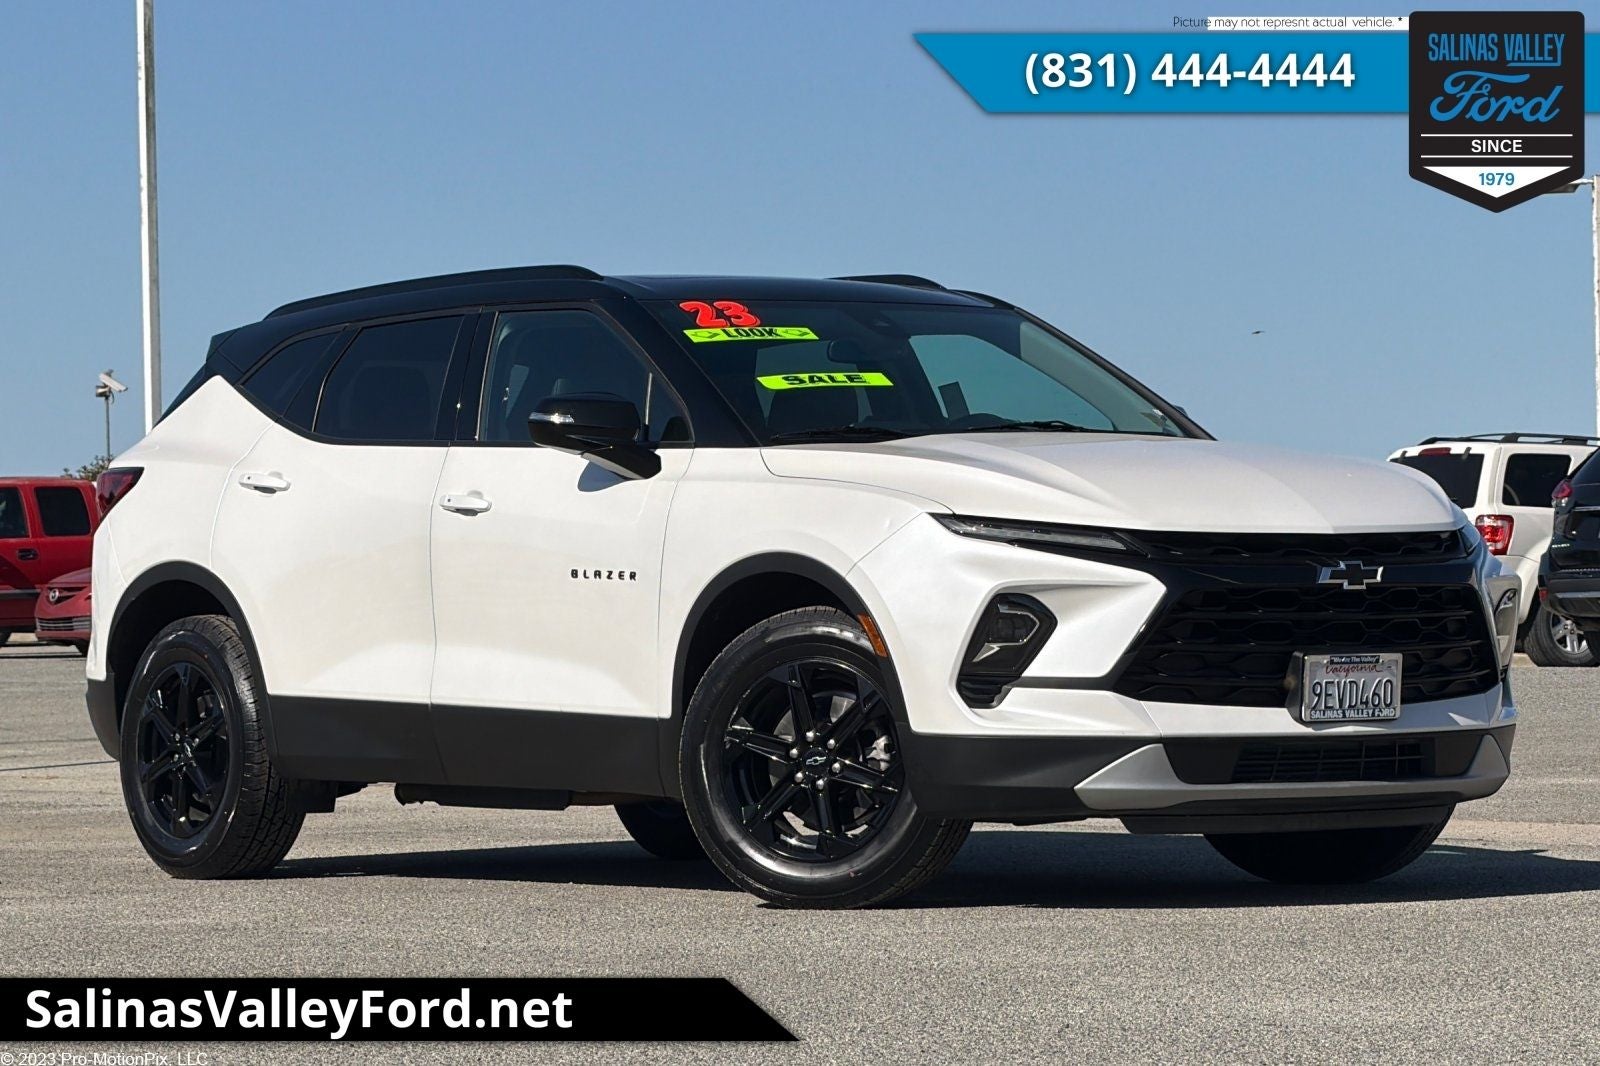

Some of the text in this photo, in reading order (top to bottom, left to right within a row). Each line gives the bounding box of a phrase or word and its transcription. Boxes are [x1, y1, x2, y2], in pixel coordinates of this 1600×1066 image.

[679, 301, 761, 327] 23
[721, 327, 780, 339] LOOK
[781, 374, 868, 386] SALE
[570, 569, 638, 581] BLAZER
[1326, 664, 1383, 678] California
[1311, 677, 1393, 709] 9EVD460
[1310, 708, 1396, 719] SALINAS VALLEY FORD
